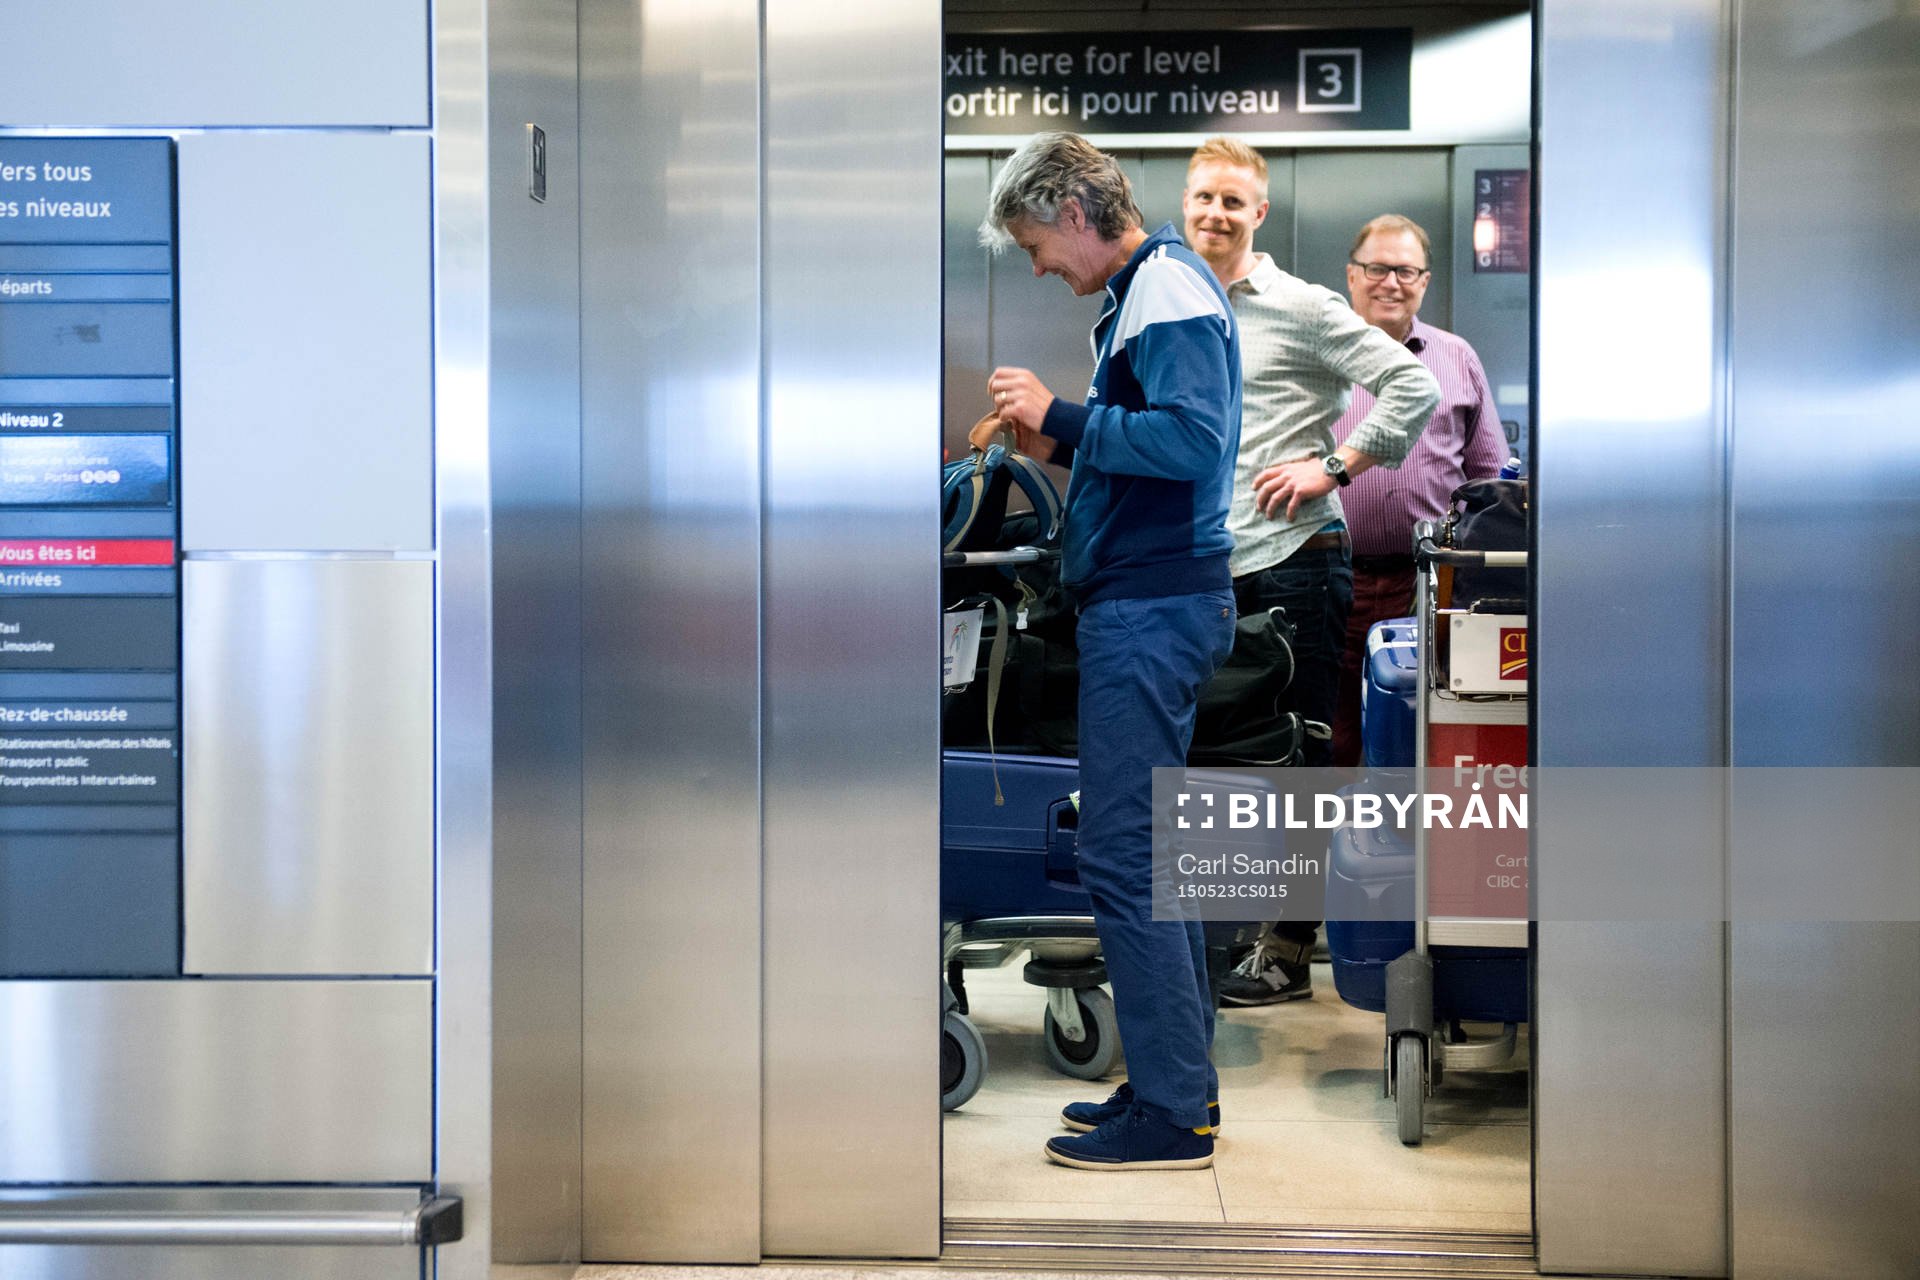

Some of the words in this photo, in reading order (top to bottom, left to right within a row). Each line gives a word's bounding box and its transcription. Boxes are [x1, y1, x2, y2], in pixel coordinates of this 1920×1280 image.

[1001, 47, 1074, 76] here
[1085, 45, 1132, 75] for
[1144, 45, 1221, 75] level
[1317, 62, 1343, 98] 3
[1033, 86, 1070, 116] ici
[1081, 91, 1158, 121] pour
[1170, 84, 1280, 115] niveau
[0, 161, 37, 181] ers
[43, 161, 92, 182] tous
[26, 197, 111, 218] niveaux
[0, 279, 53, 297] éparts
[52, 411, 64, 428] 2
[0, 546, 34, 561] Vous
[38, 544, 73, 561] êtes
[77, 545, 96, 561] ici
[0, 571, 62, 588] Arrivées
[0, 706, 128, 722] Rez-de-chaussée
[0, 756, 52, 769] Transport
[54, 755, 90, 769] public
[1486, 875, 1521, 889] CIBC
